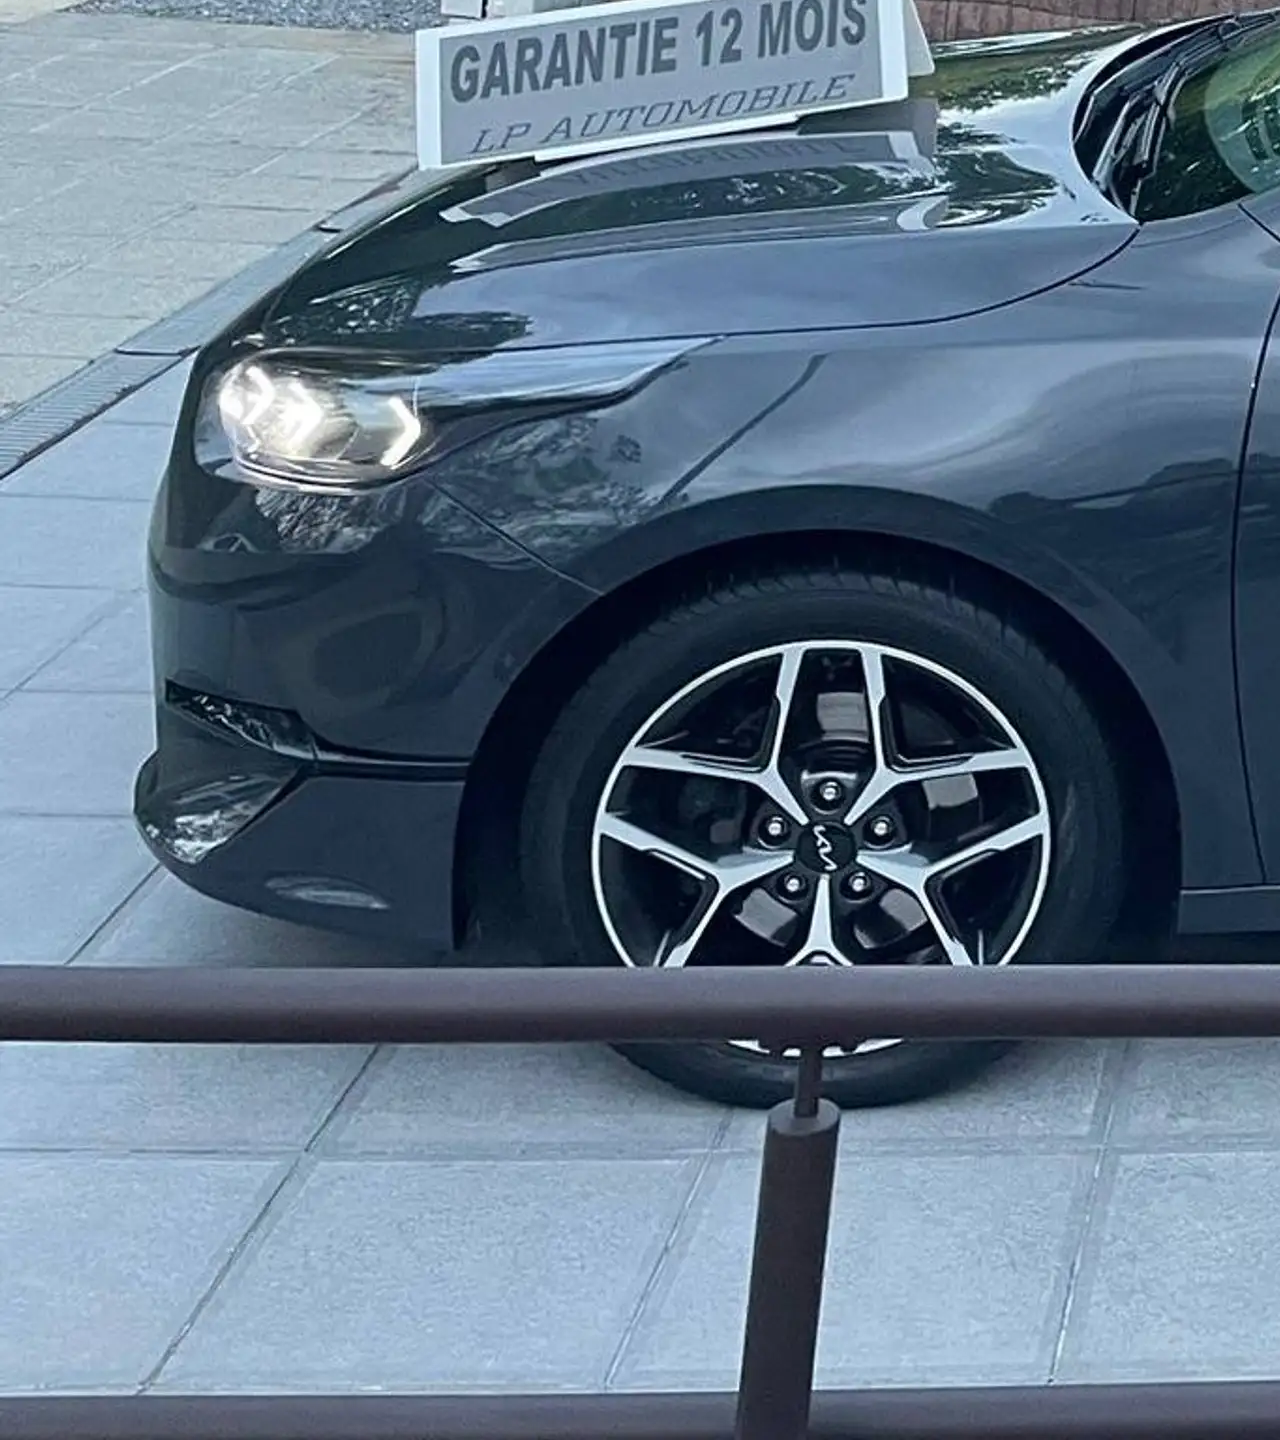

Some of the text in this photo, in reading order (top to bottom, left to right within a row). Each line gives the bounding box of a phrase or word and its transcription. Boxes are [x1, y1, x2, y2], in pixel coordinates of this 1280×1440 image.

[451, 17, 679, 103] GARANTIE
[696, 7, 742, 67] 12
[469, 74, 855, 154] LP AUTOMOBILE
